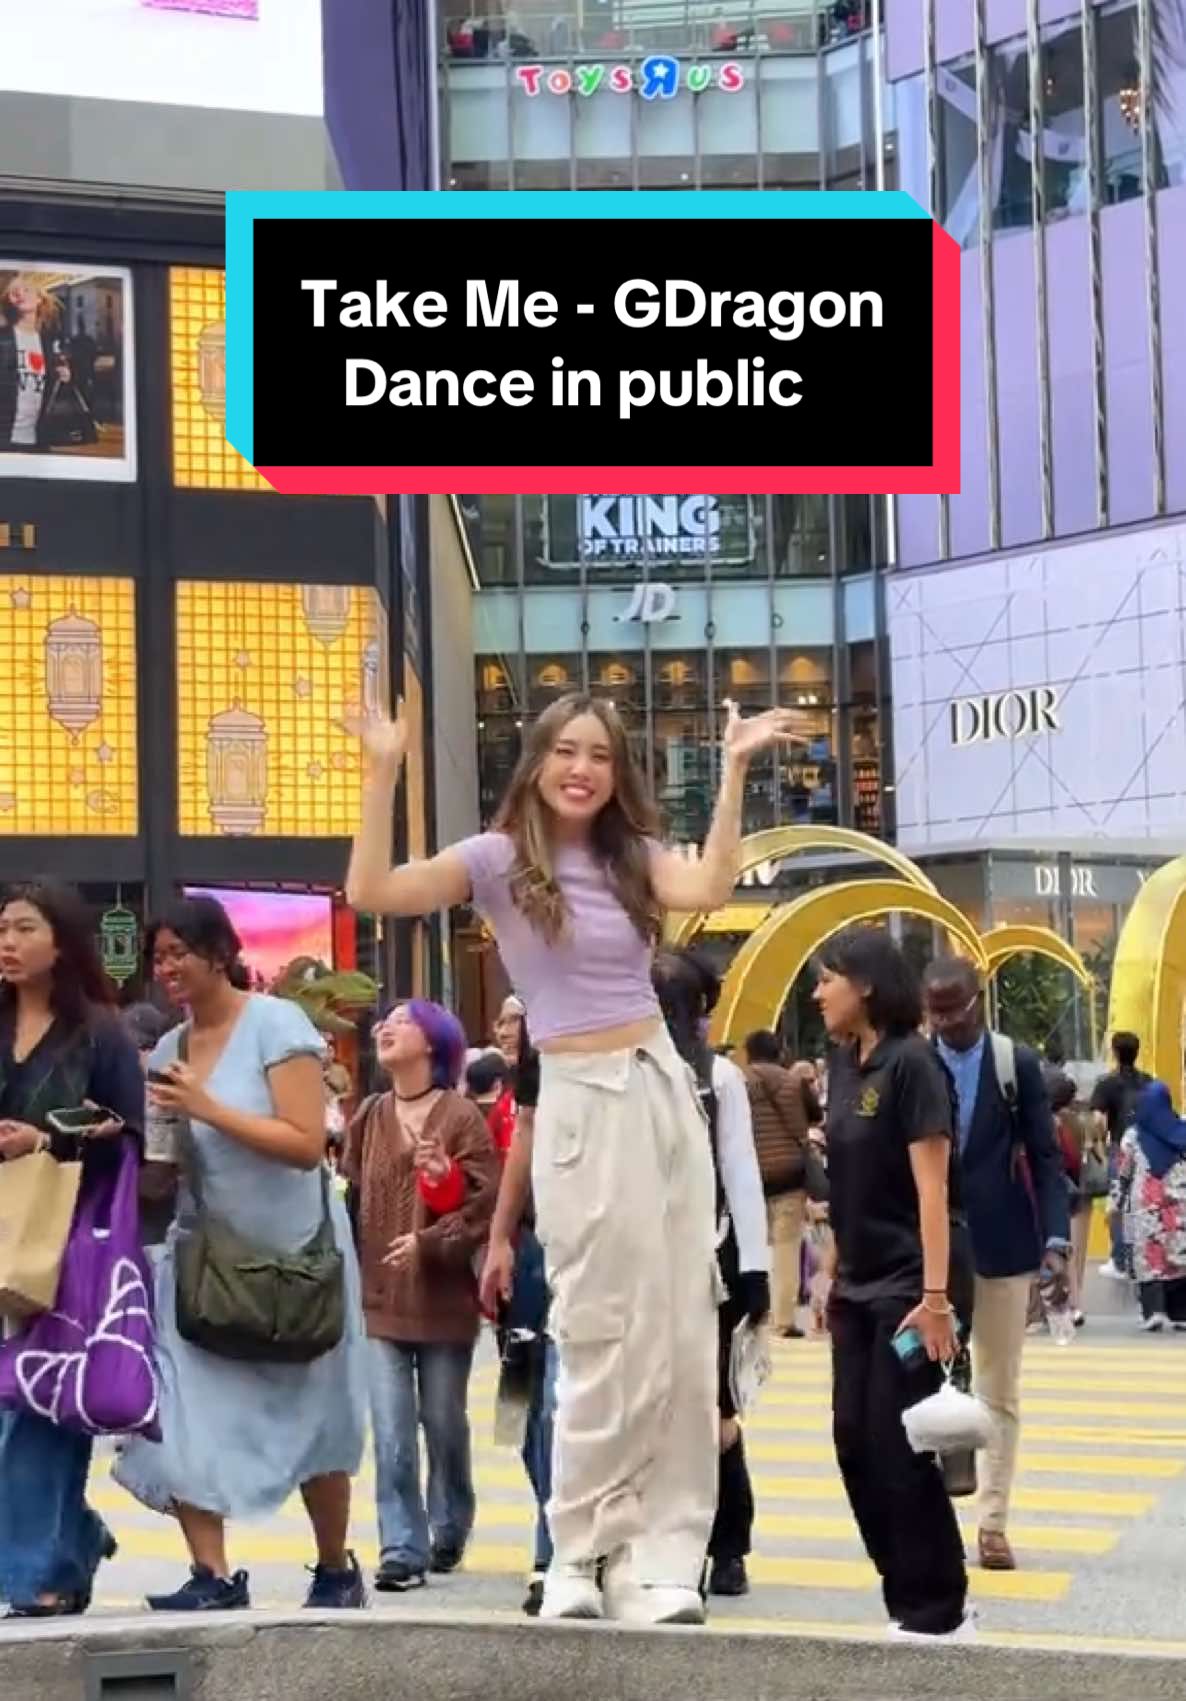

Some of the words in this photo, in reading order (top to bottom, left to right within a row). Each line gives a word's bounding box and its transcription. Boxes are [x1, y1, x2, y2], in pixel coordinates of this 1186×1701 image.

[515, 65, 632, 96] TOYS
[687, 63, 743, 92] US
[578, 496, 720, 537] KING
[610, 536, 721, 555] TRAINERS
[618, 583, 676, 622] JD
[950, 687, 1058, 746] DIOR
